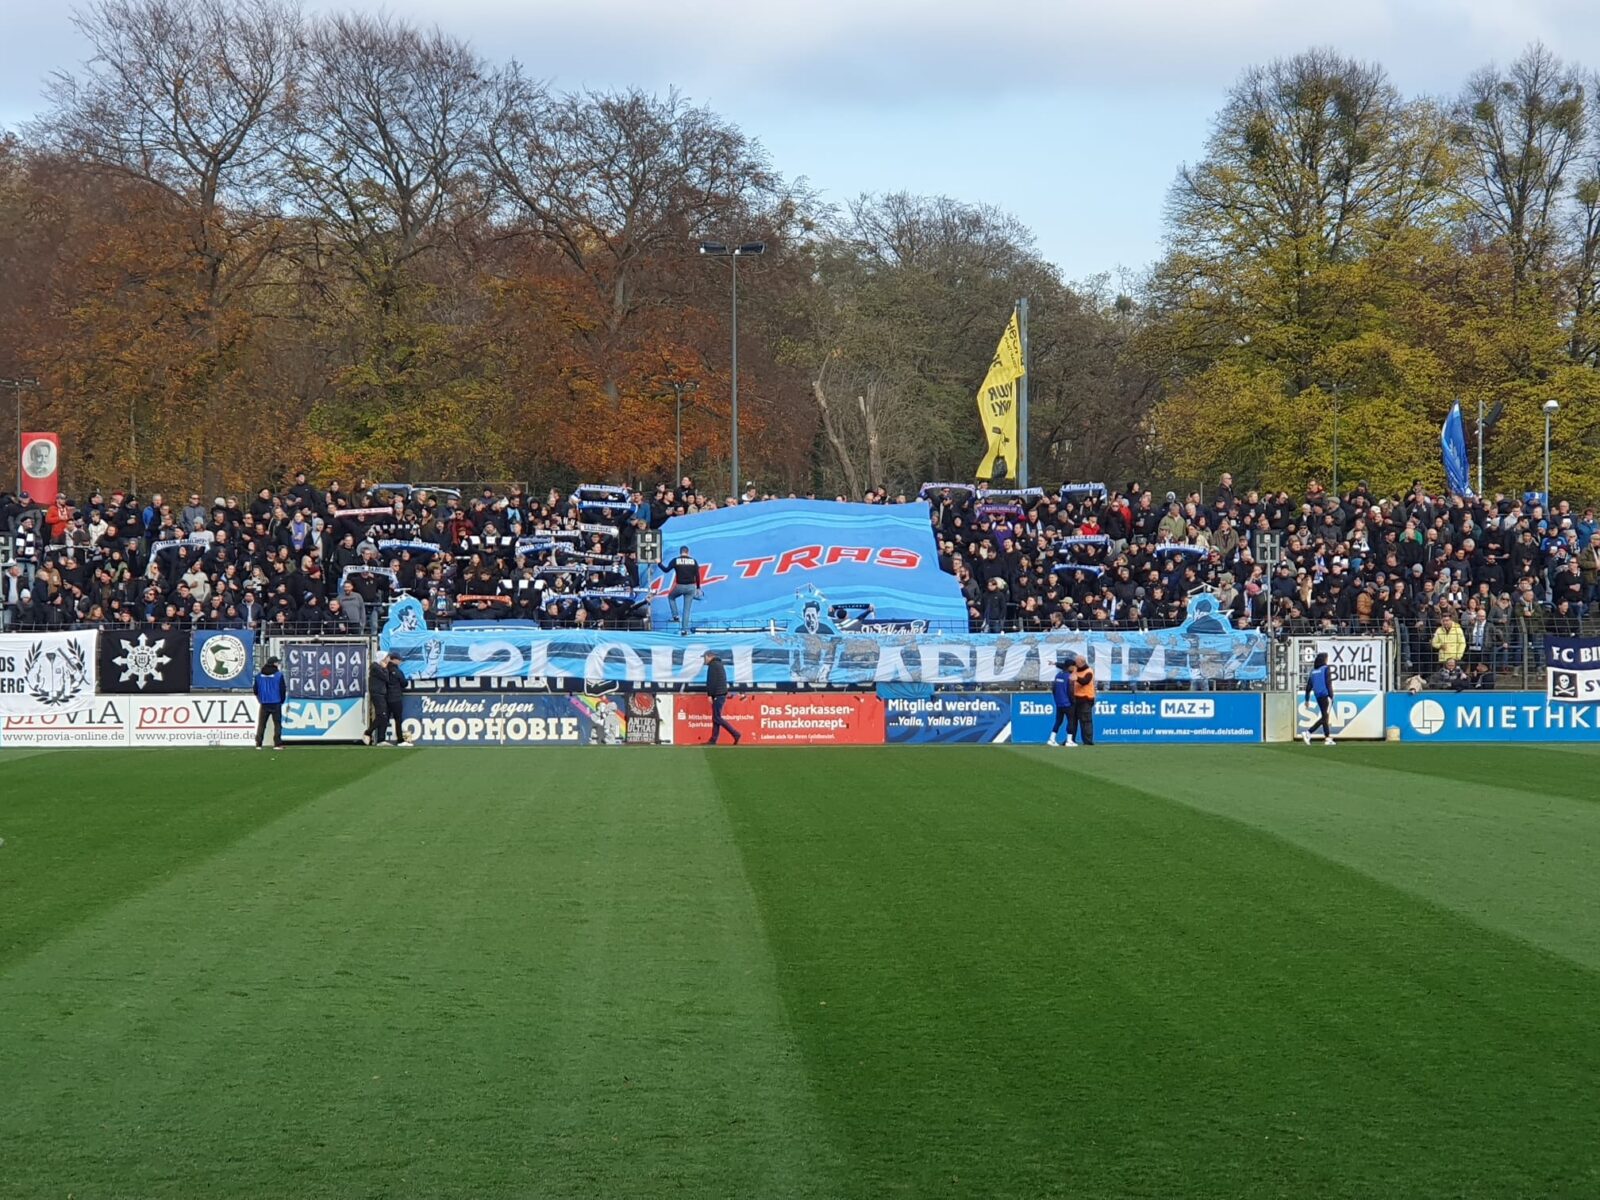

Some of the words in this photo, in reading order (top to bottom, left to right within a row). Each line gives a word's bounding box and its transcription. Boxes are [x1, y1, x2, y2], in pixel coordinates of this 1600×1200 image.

[650, 544, 922, 597] ULTRAS
[1332, 643, 1372, 663] ХУЙ
[1552, 646, 1574, 663] FC
[1329, 663, 1376, 683] ВОЙНЕ
[0, 678, 25, 693] ERG
[421, 696, 485, 713] Nulldrei
[489, 700, 534, 717] gegen
[760, 704, 782, 715] Das
[785, 704, 855, 717] Sparkassen-
[888, 698, 942, 713] Mitglied
[945, 699, 1000, 711] werden.
[1019, 701, 1053, 714] Eine
[1094, 701, 1117, 715] für
[1121, 701, 1156, 715] sich:
[138, 700, 254, 728] proVIA
[281, 702, 341, 729] SAP
[889, 716, 924, 727] ...Yalla,
[927, 716, 951, 726] Yalla
[952, 716, 977, 726] SVB!
[760, 717, 847, 730] Finanzkonzept.
[3, 731, 124, 742] www.provia-online.de
[135, 731, 255, 743] www.provia-online.de
[1155, 728, 1253, 736] www.maz-online.de/stadion
